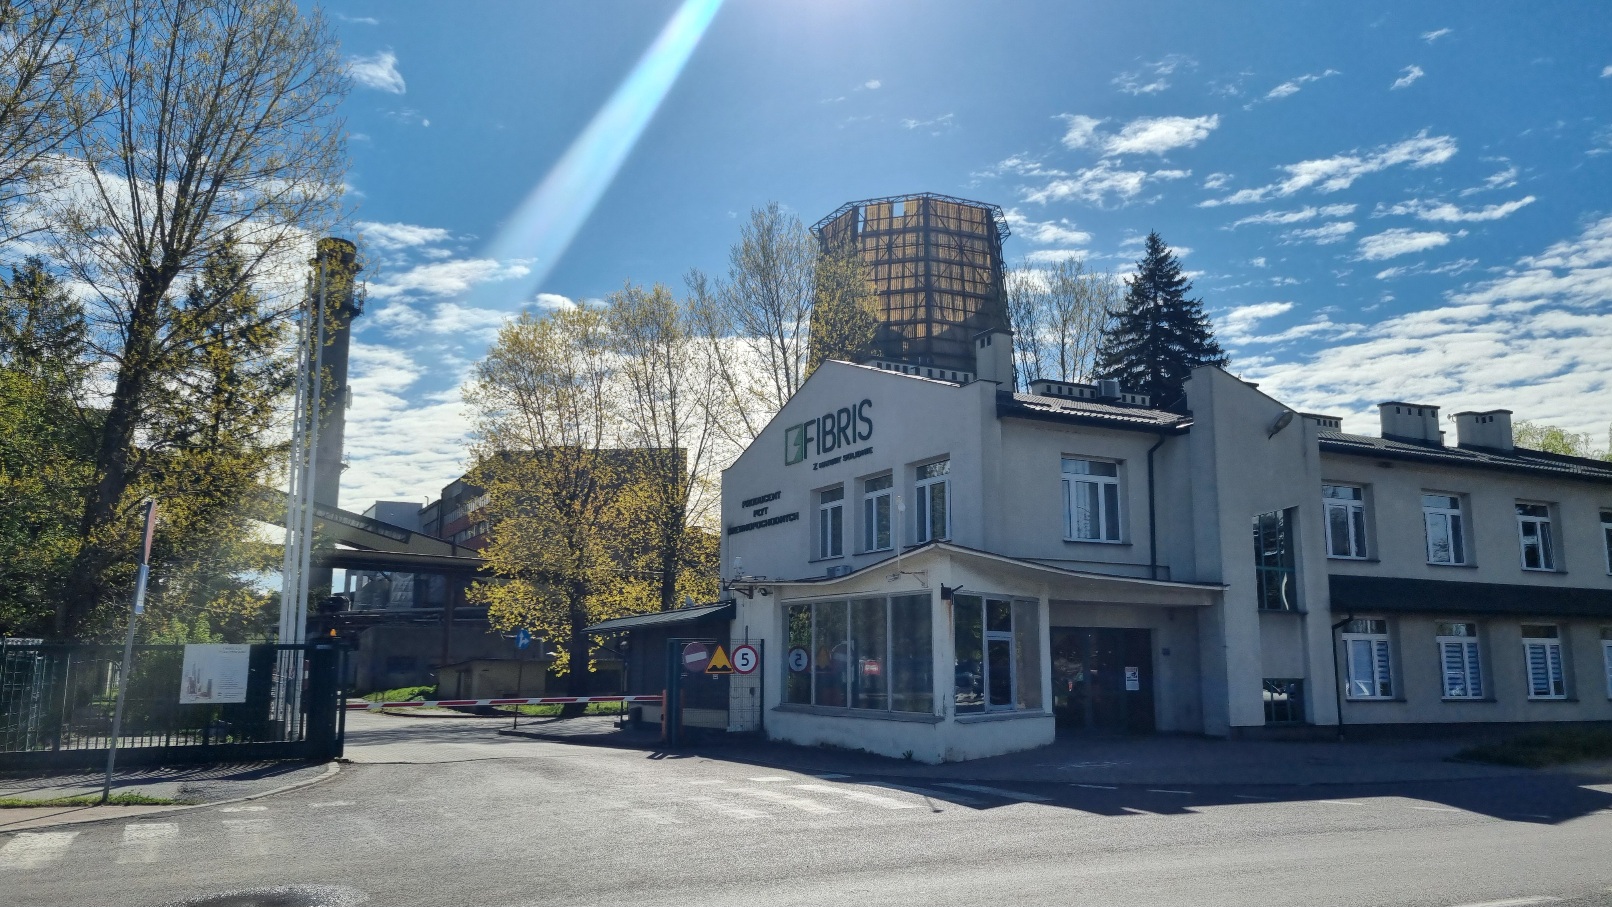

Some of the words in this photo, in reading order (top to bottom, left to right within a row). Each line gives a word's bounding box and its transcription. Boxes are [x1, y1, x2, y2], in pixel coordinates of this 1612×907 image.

[803, 398, 873, 459] FIBRIS
[812, 462, 818, 471] Z
[741, 652, 749, 667] 5
